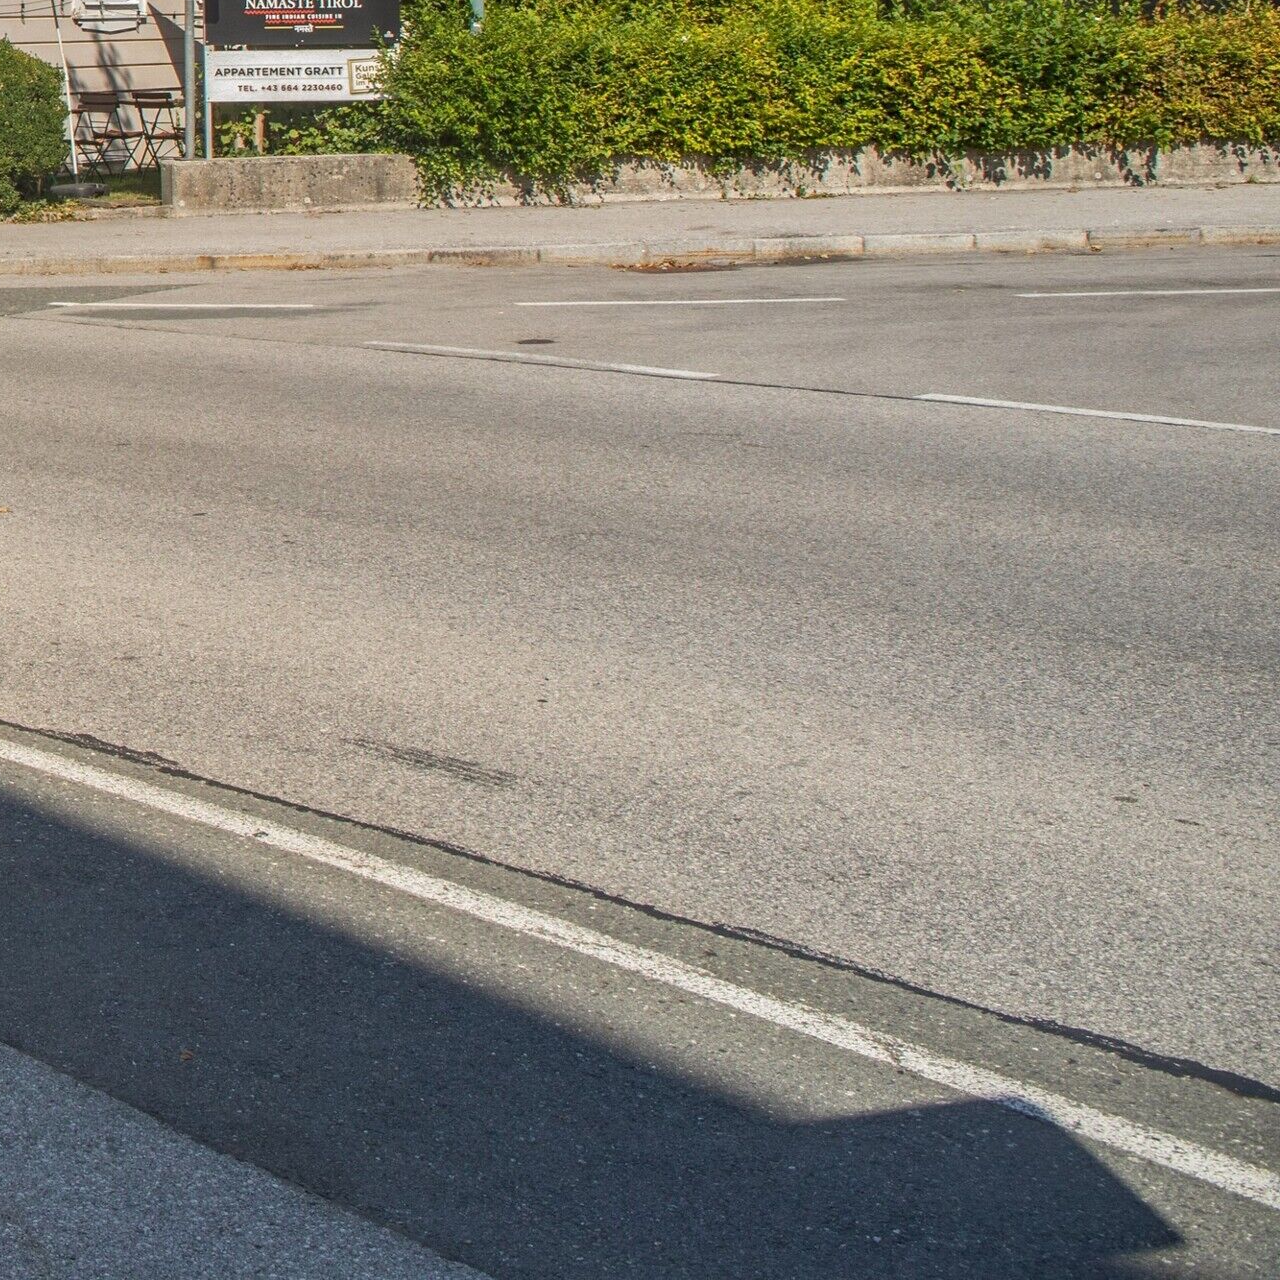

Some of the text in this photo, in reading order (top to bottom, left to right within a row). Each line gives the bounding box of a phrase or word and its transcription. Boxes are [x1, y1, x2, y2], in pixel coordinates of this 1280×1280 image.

[214, 66, 343, 77] APPARTEMENT GRATT
[301, 84, 343, 92] 2230460
